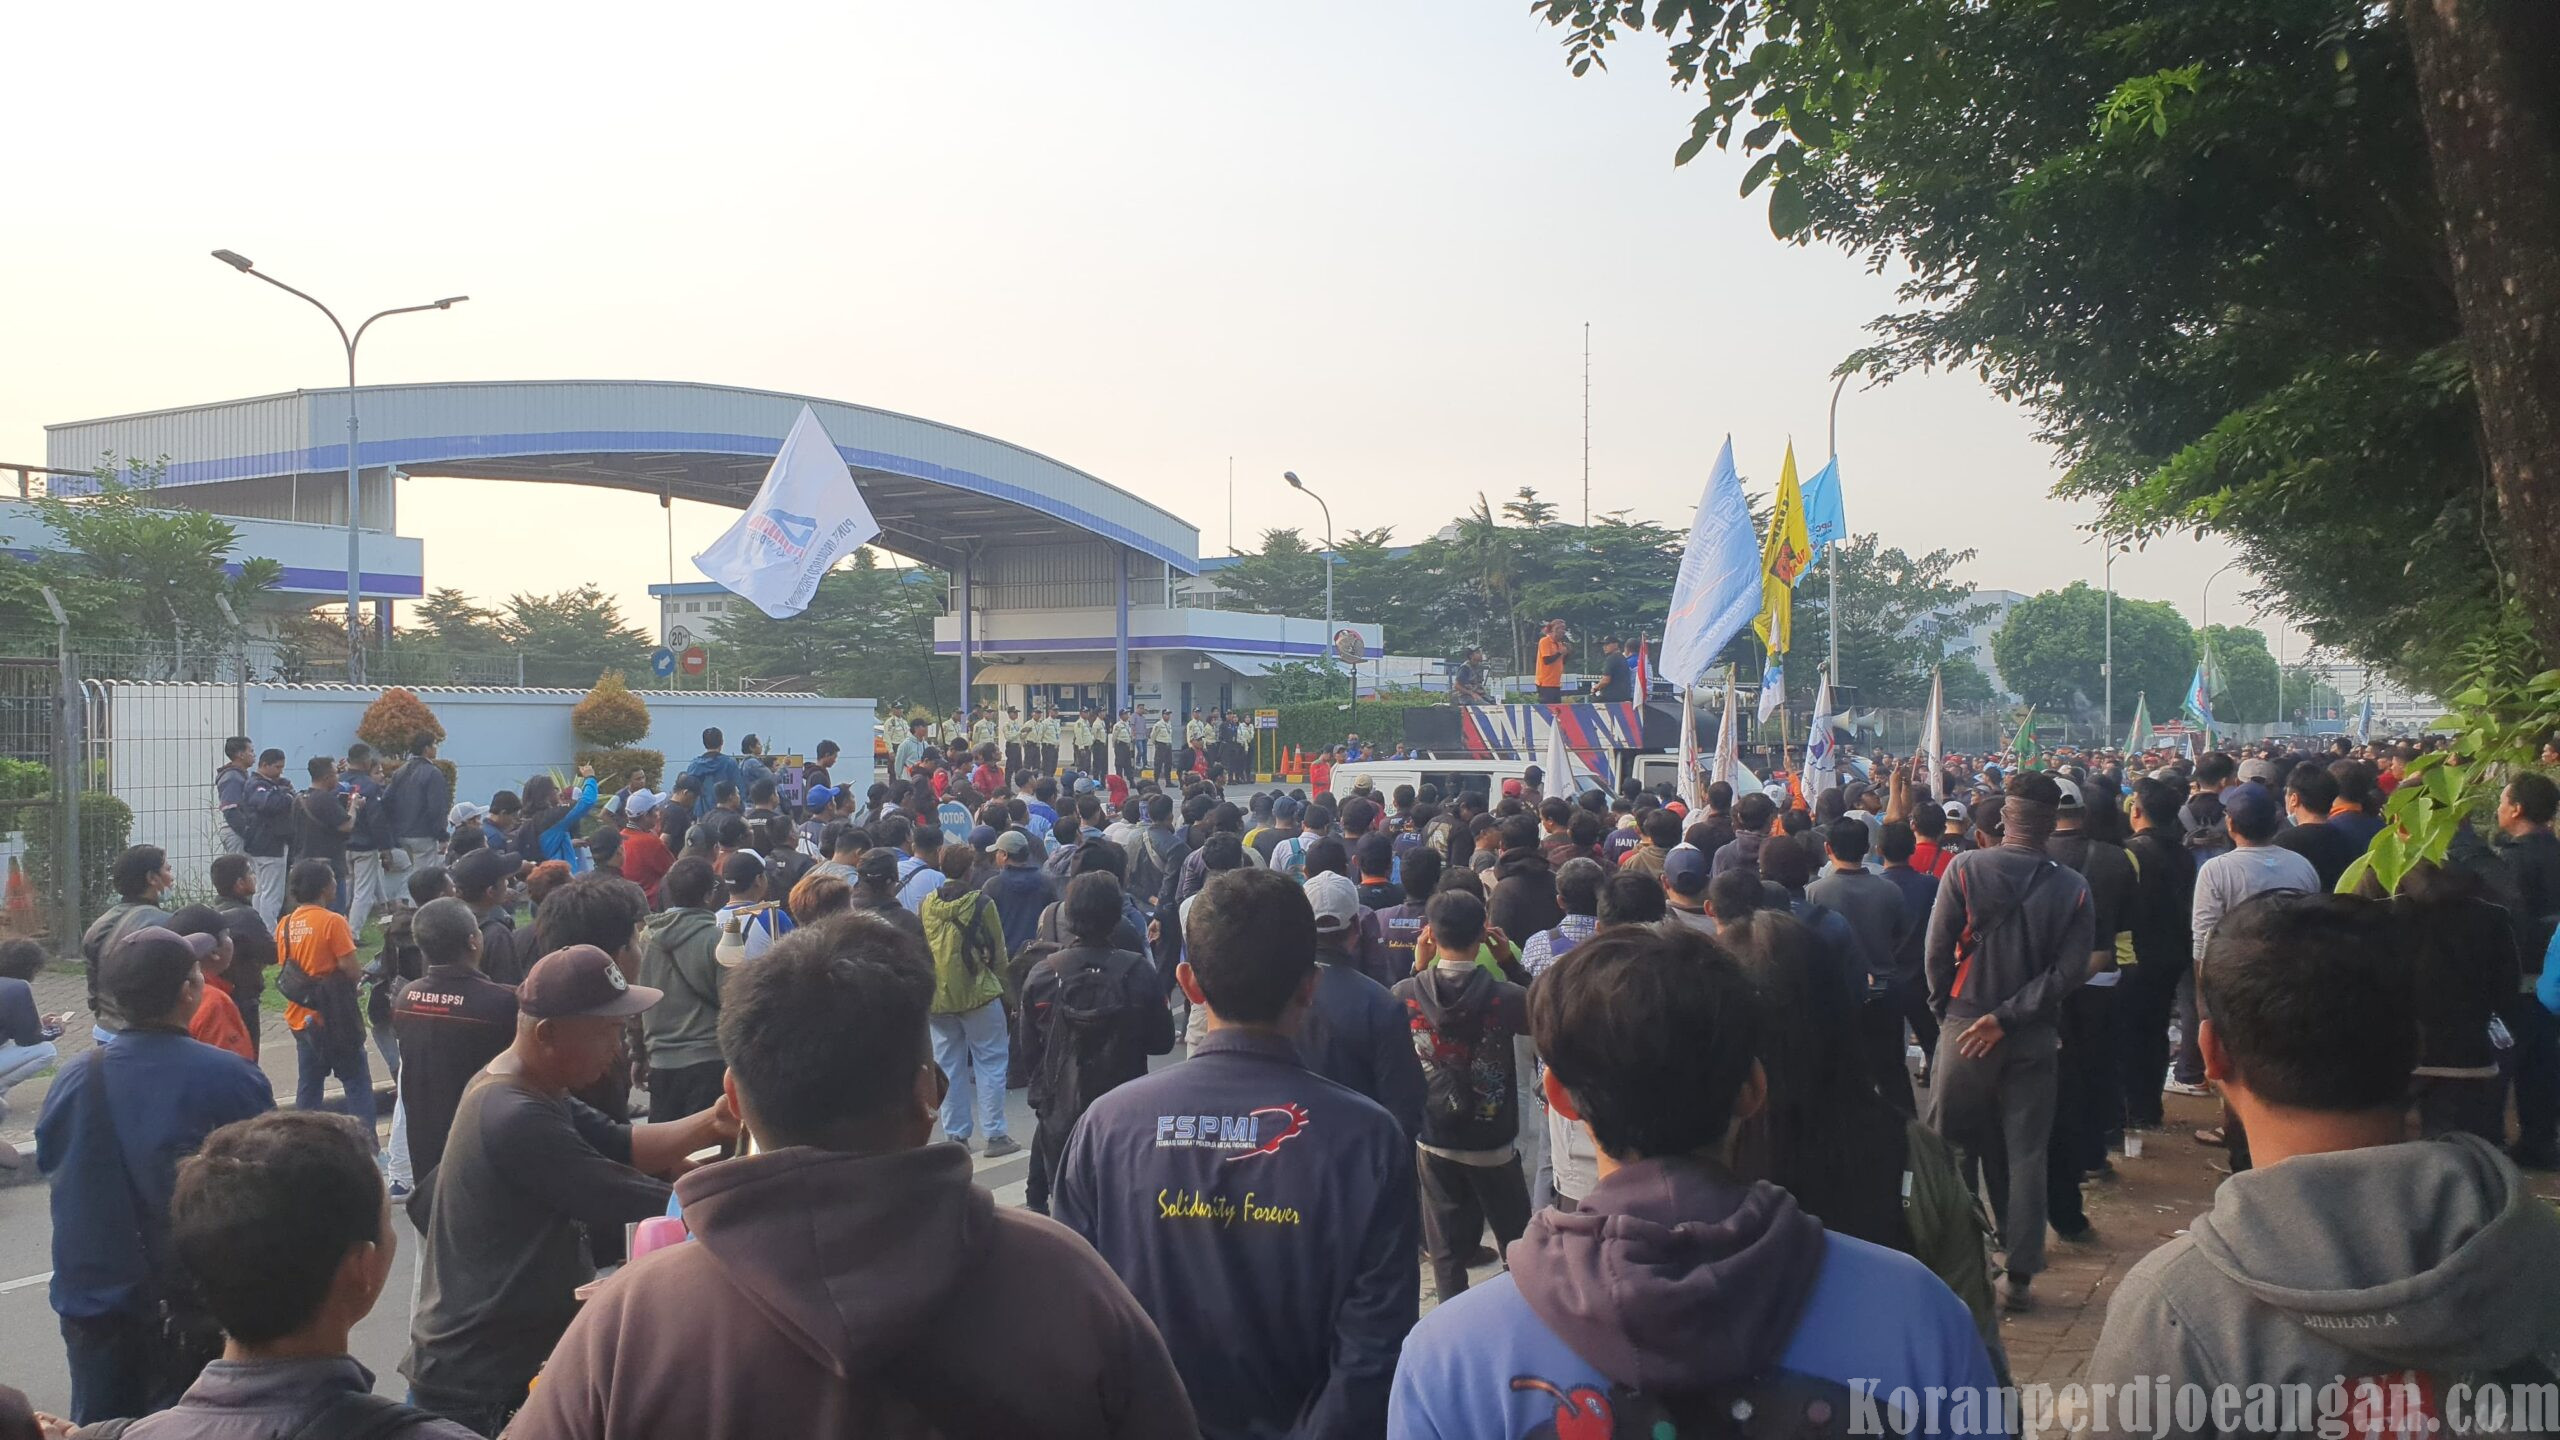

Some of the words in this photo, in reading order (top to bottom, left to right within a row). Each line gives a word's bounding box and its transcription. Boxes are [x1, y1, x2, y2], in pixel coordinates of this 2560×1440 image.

[671, 631, 683, 646] 20
[407, 990, 421, 1001] FSP
[421, 992, 440, 1003] LEM
[441, 994, 464, 1005] SPSI
[1156, 1115, 1259, 1142] FSPMI
[1158, 1188, 1236, 1229] Solidarity
[1243, 1192, 1300, 1225] Forever
